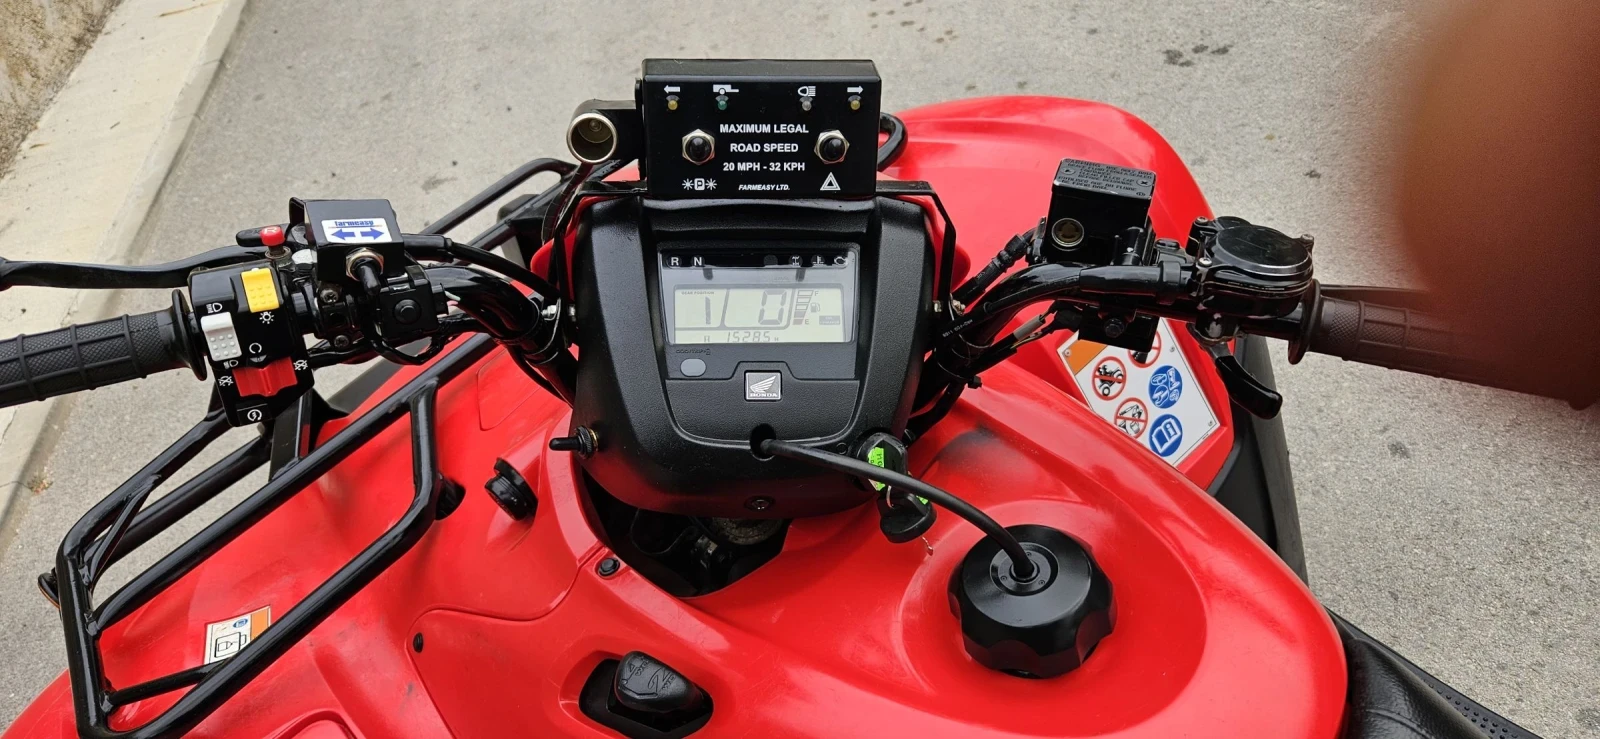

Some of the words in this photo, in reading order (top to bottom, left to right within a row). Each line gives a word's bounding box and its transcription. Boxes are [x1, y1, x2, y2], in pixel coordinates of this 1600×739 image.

[720, 124, 771, 133] MAXIMUM
[773, 124, 809, 133] LEGAL
[730, 143, 761, 152] ROAD
[763, 143, 799, 152] SPEED
[723, 162, 735, 171] 20
[737, 162, 760, 171] MPH
[769, 162, 781, 171] 32
[783, 162, 805, 171] KPH
[670, 257, 680, 266] R
[693, 257, 703, 266] N
[758, 289, 787, 325] 0
